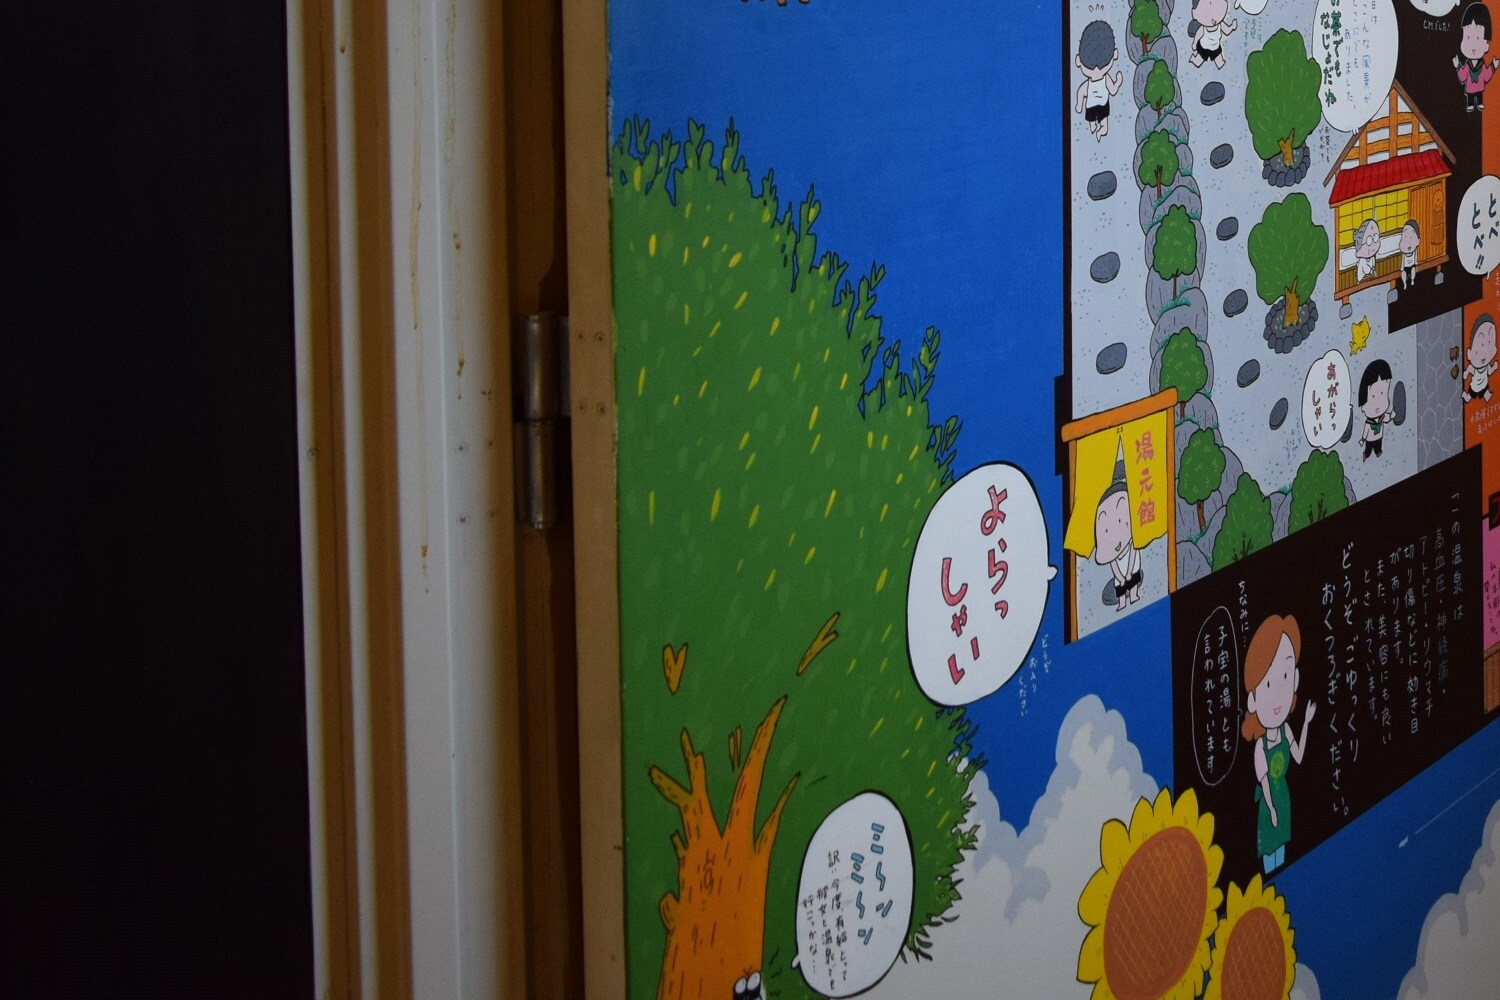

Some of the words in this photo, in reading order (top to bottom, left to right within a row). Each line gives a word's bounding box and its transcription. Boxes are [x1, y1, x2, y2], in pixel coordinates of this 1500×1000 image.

[1487, 191, 1500, 240] とべ
[1310, 392, 1322, 437] しゃい
[1326, 361, 1339, 432] あがらっ
[1134, 429, 1158, 528] 湯元館
[979, 483, 1010, 620] よらっ
[1389, 546, 1405, 664] があります。
[1451, 491, 1464, 621] この温泉は
[939, 556, 980, 686] しゃい
[1341, 541, 1360, 763] どうぞごゆっくり
[1363, 568, 1379, 720] とされています。
[1403, 543, 1419, 734] 切り傷などに効き目
[1203, 633, 1216, 775] 言われています
[1217, 625, 1232, 754] 子宝の湯とも
[1322, 582, 1349, 816] おくつろぎください。
